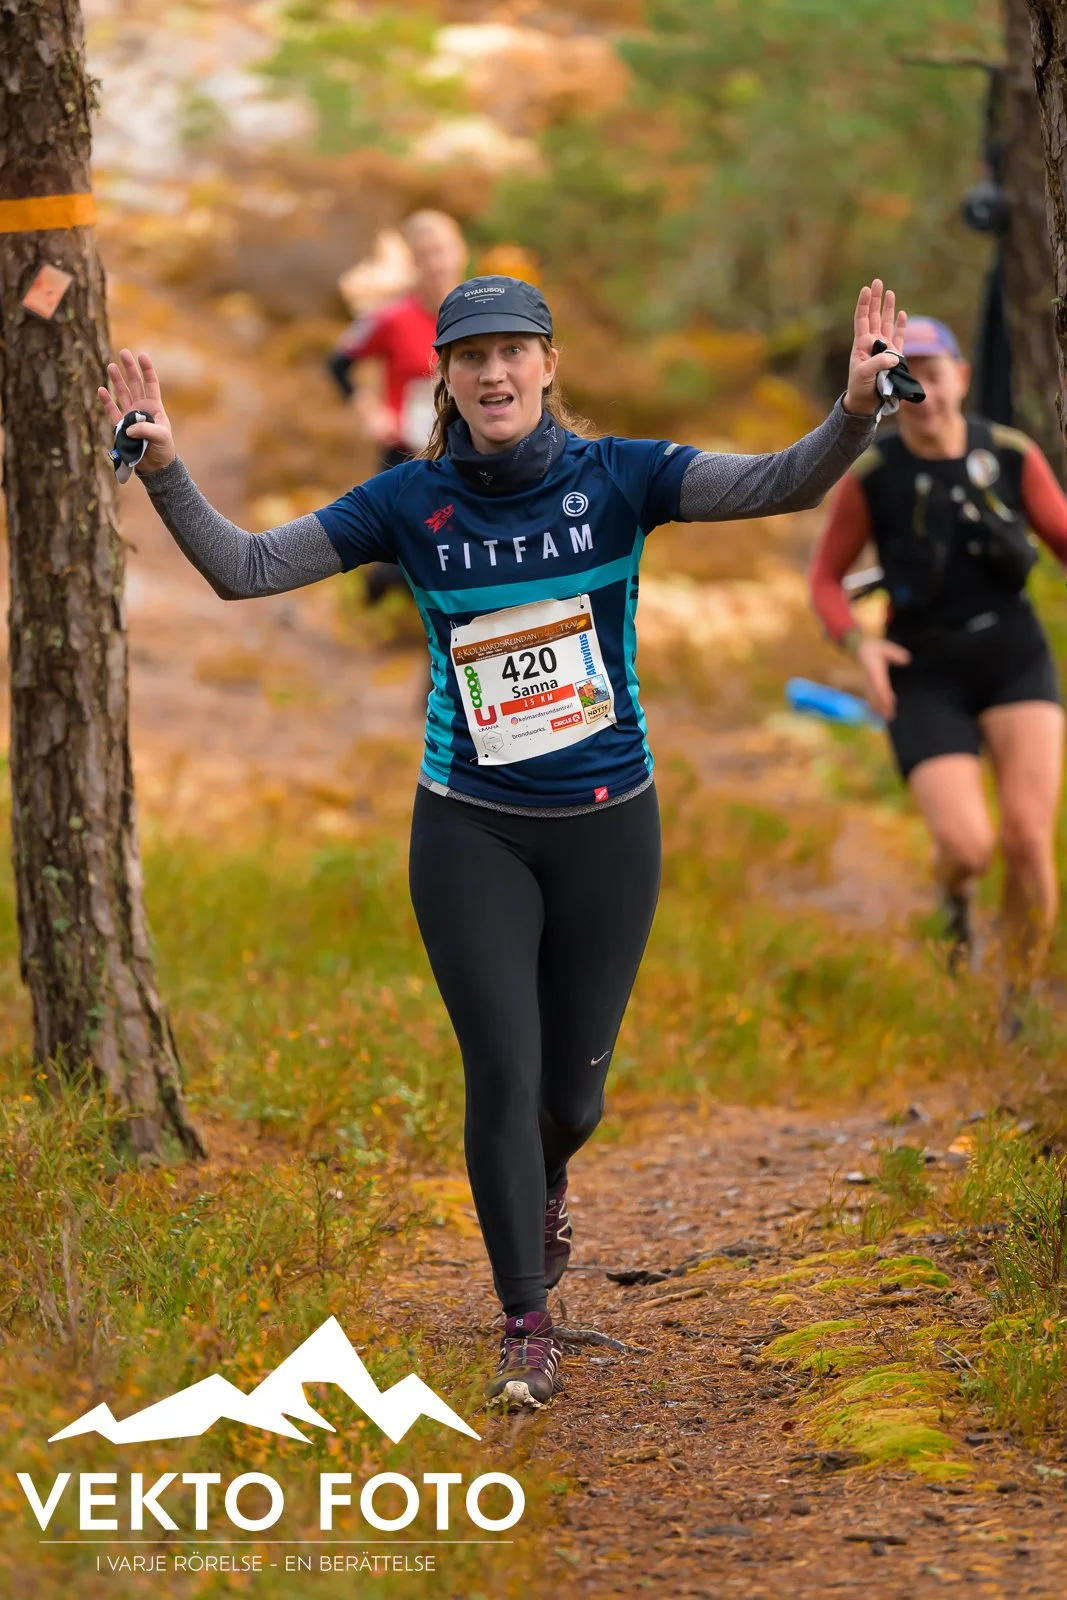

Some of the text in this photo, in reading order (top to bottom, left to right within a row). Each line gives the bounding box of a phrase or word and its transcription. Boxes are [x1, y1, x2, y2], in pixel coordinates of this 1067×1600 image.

[437, 523, 594, 572] FITFAM
[502, 646, 557, 683] 420
[579, 633, 597, 676] Aktivitus
[464, 665, 482, 708] coop
[511, 679, 559, 699] Sanna
[523, 693, 553, 708] 15 KM
[553, 718, 573, 728] CIRCLE
